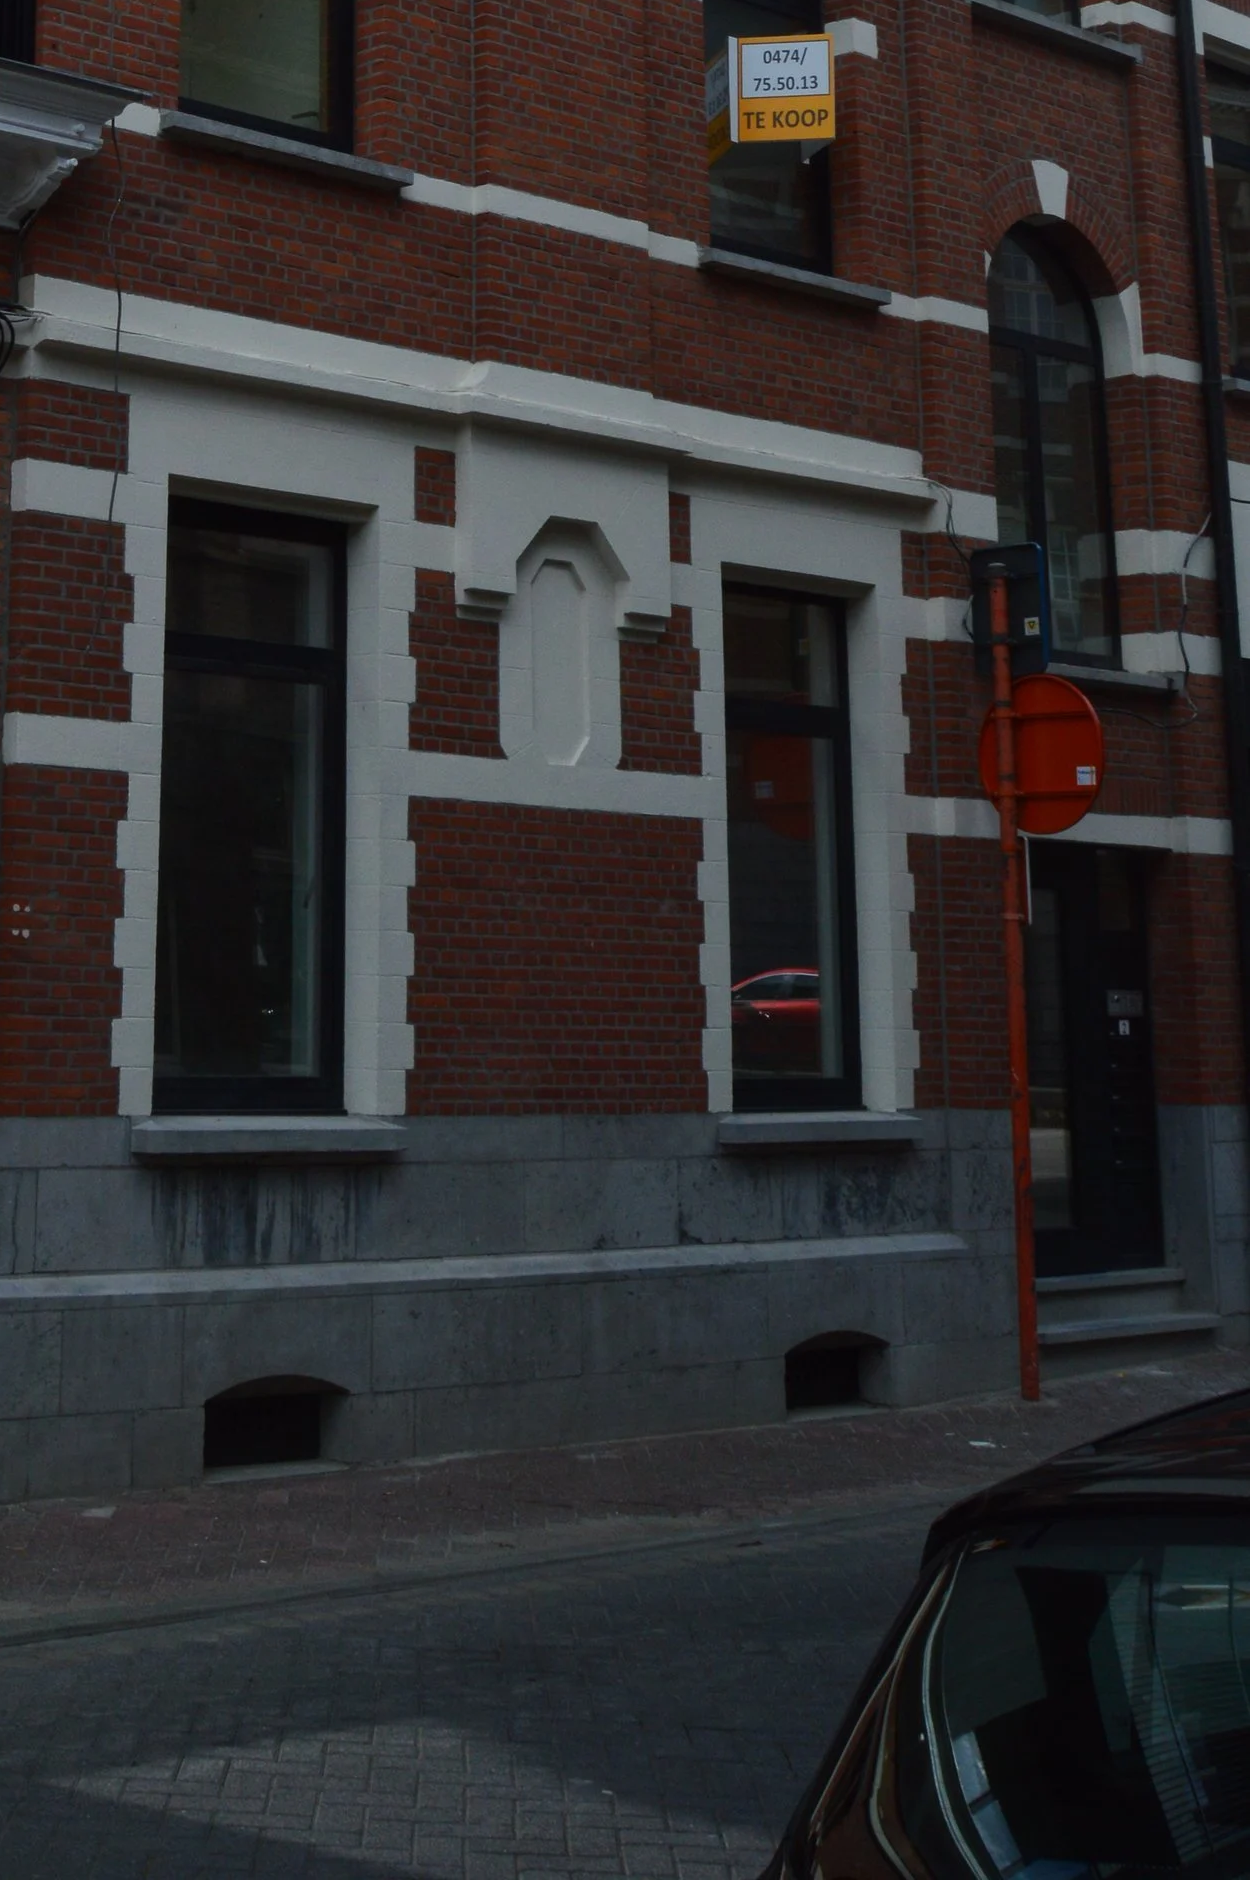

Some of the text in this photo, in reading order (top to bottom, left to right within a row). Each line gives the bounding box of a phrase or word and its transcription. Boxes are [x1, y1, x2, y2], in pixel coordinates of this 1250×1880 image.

[763, 47, 808, 66] 0474/
[753, 75, 819, 92] 75.50.13
[743, 108, 829, 130] TE KOOP
